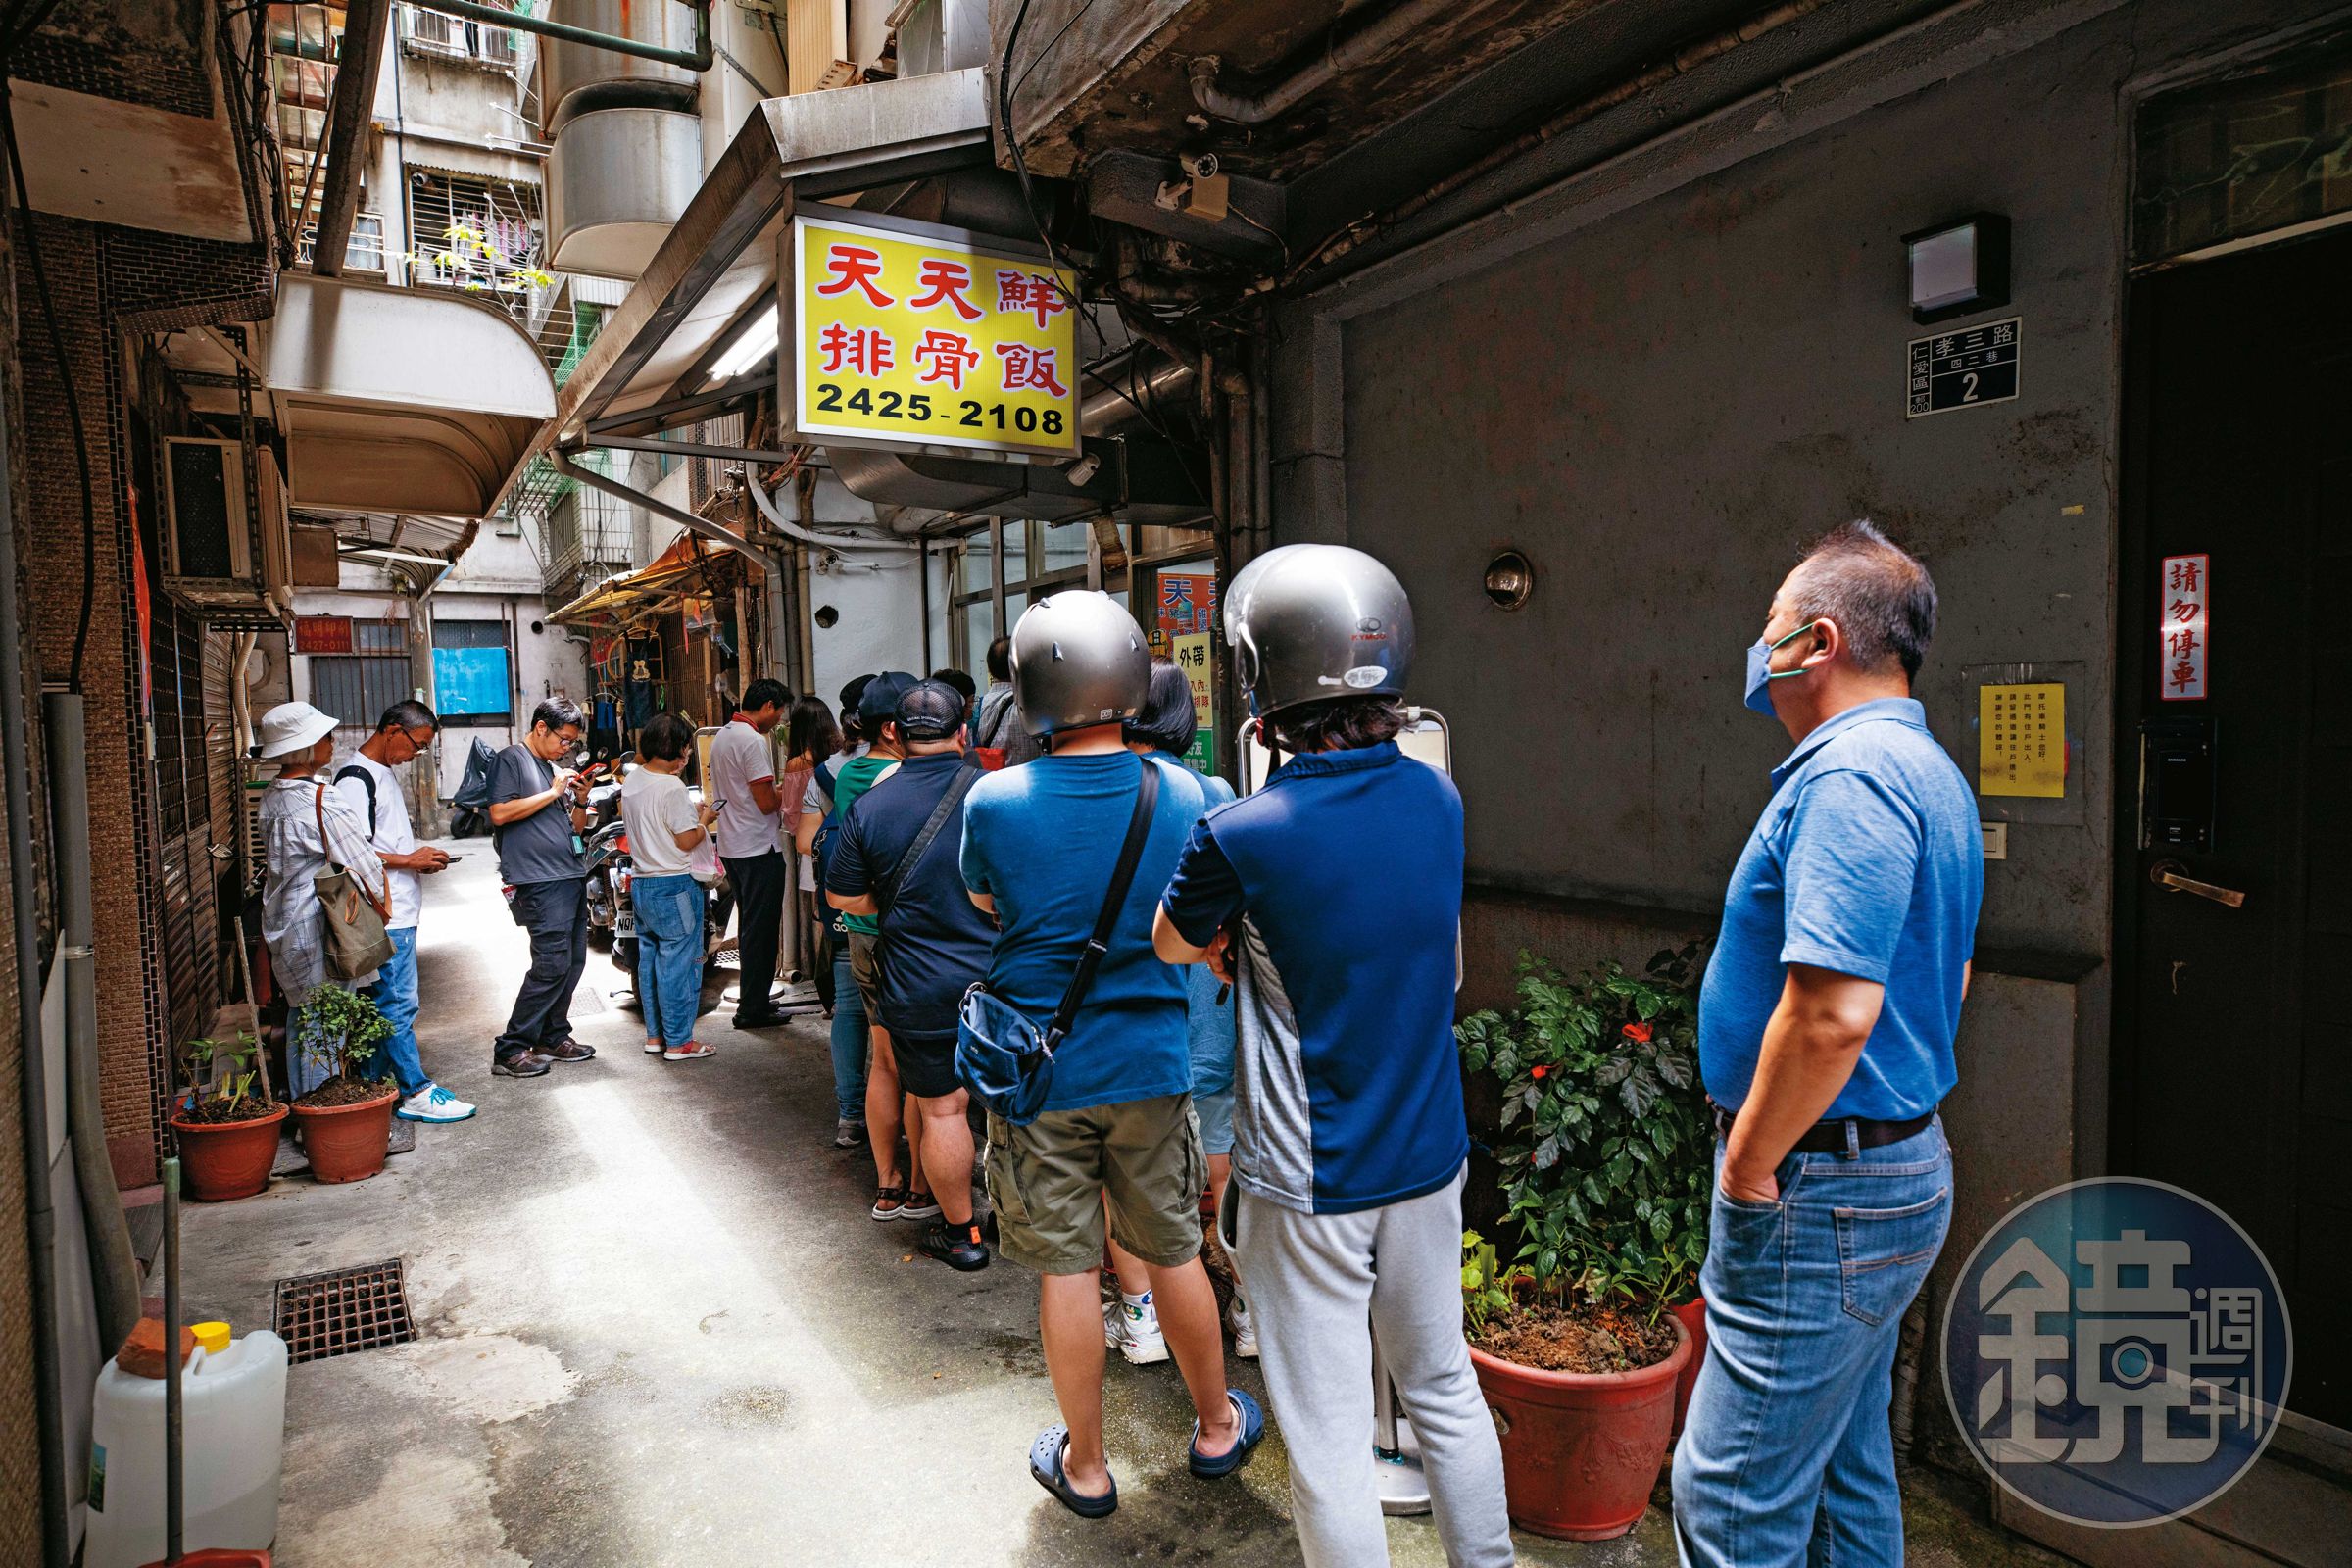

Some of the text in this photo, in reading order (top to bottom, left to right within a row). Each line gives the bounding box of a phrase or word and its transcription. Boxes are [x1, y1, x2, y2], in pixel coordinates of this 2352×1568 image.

[817, 245, 1066, 328] 天天鮮
[820, 323, 1067, 397] 排骨飯
[1936, 324, 2013, 357] 孝三路
[1950, 350, 1998, 369] 四二巷
[1912, 346, 1929, 391] 仁愛區
[1962, 372, 1979, 403] 2
[816, 383, 1063, 435] 2425-2108
[1911, 402, 1929, 414] 200
[2168, 562, 2202, 693] 請勿停車
[1179, 645, 1205, 669] 外帶
